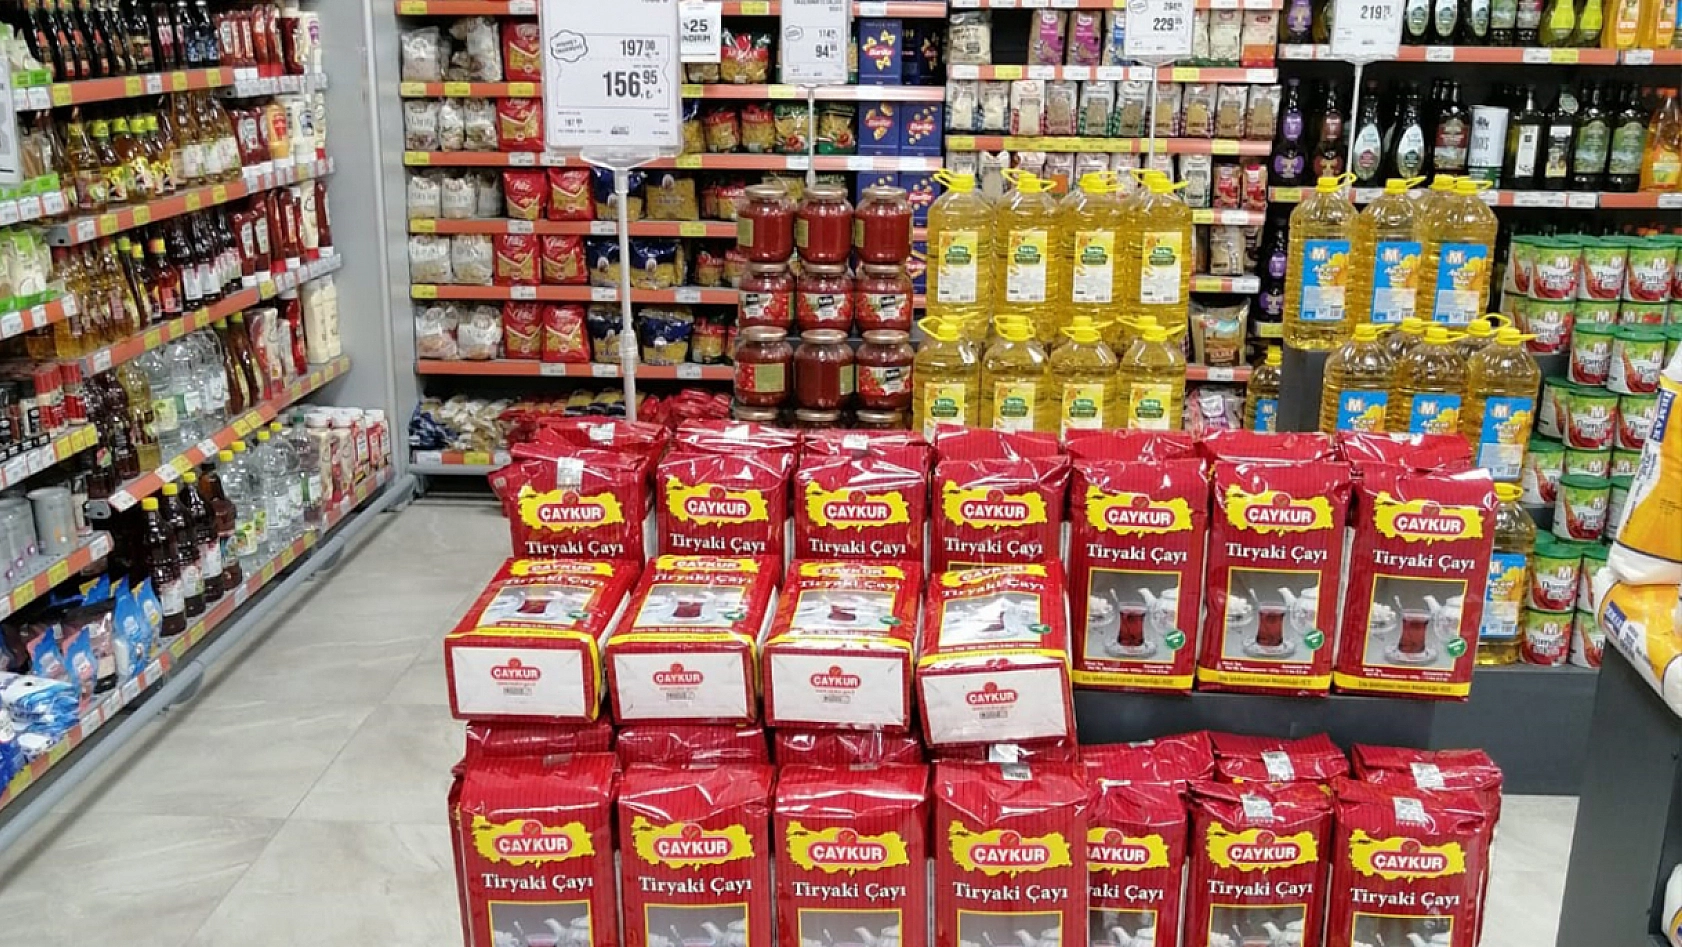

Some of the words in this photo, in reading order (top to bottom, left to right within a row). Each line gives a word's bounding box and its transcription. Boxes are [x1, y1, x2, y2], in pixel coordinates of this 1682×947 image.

[540, 503, 603, 521] ÇAYKUR
[687, 500, 747, 516] ÇAYKUR
[826, 503, 888, 519] ÇAYKUR
[963, 503, 1026, 519] ÇAYKUR
[1108, 509, 1171, 525] ÇAYKUR
[1249, 508, 1312, 523] ÇAYKUR
[1396, 516, 1462, 532] ÇAYKUR
[524, 541, 584, 556] Tiryaki
[588, 540, 624, 557] Çayı
[670, 533, 726, 551] Tiryaki
[730, 536, 766, 552] Çayı
[808, 538, 866, 556] Tiryaki
[870, 540, 907, 557] Çayı
[945, 537, 1002, 556] Tiryaki
[1006, 540, 1043, 557] Çayı
[1086, 543, 1146, 562] Tiryaki
[1151, 547, 1188, 565] Çayı
[1225, 542, 1286, 561] Tiryaki
[1290, 546, 1328, 564] Çayı
[1372, 549, 1434, 570] Tiryaki
[1438, 554, 1476, 571] Çayı
[498, 838, 568, 853] ÇAYKUR
[658, 841, 728, 856] ÇAYKUR
[813, 846, 883, 862] ÇAYKUR
[1231, 847, 1296, 862] ÇAYKUR
[974, 847, 1045, 863] ÇAYKUR
[1374, 854, 1443, 870] ÇAYKUR
[481, 873, 547, 893] Tiryaki
[552, 874, 594, 893] Çayı
[638, 876, 706, 895] Tiryaki
[710, 877, 753, 897] Çayı
[792, 881, 860, 901] Tiryaki
[865, 883, 907, 900] Çayı
[953, 881, 1021, 901] Tiryaki
[1025, 884, 1068, 903] Çayı
[1207, 879, 1270, 898] Tiryaki
[1276, 882, 1313, 898] Çayı
[1125, 885, 1164, 903] Çayı
[1350, 887, 1415, 908] Tiryaki
[1420, 891, 1460, 908] Çayı
